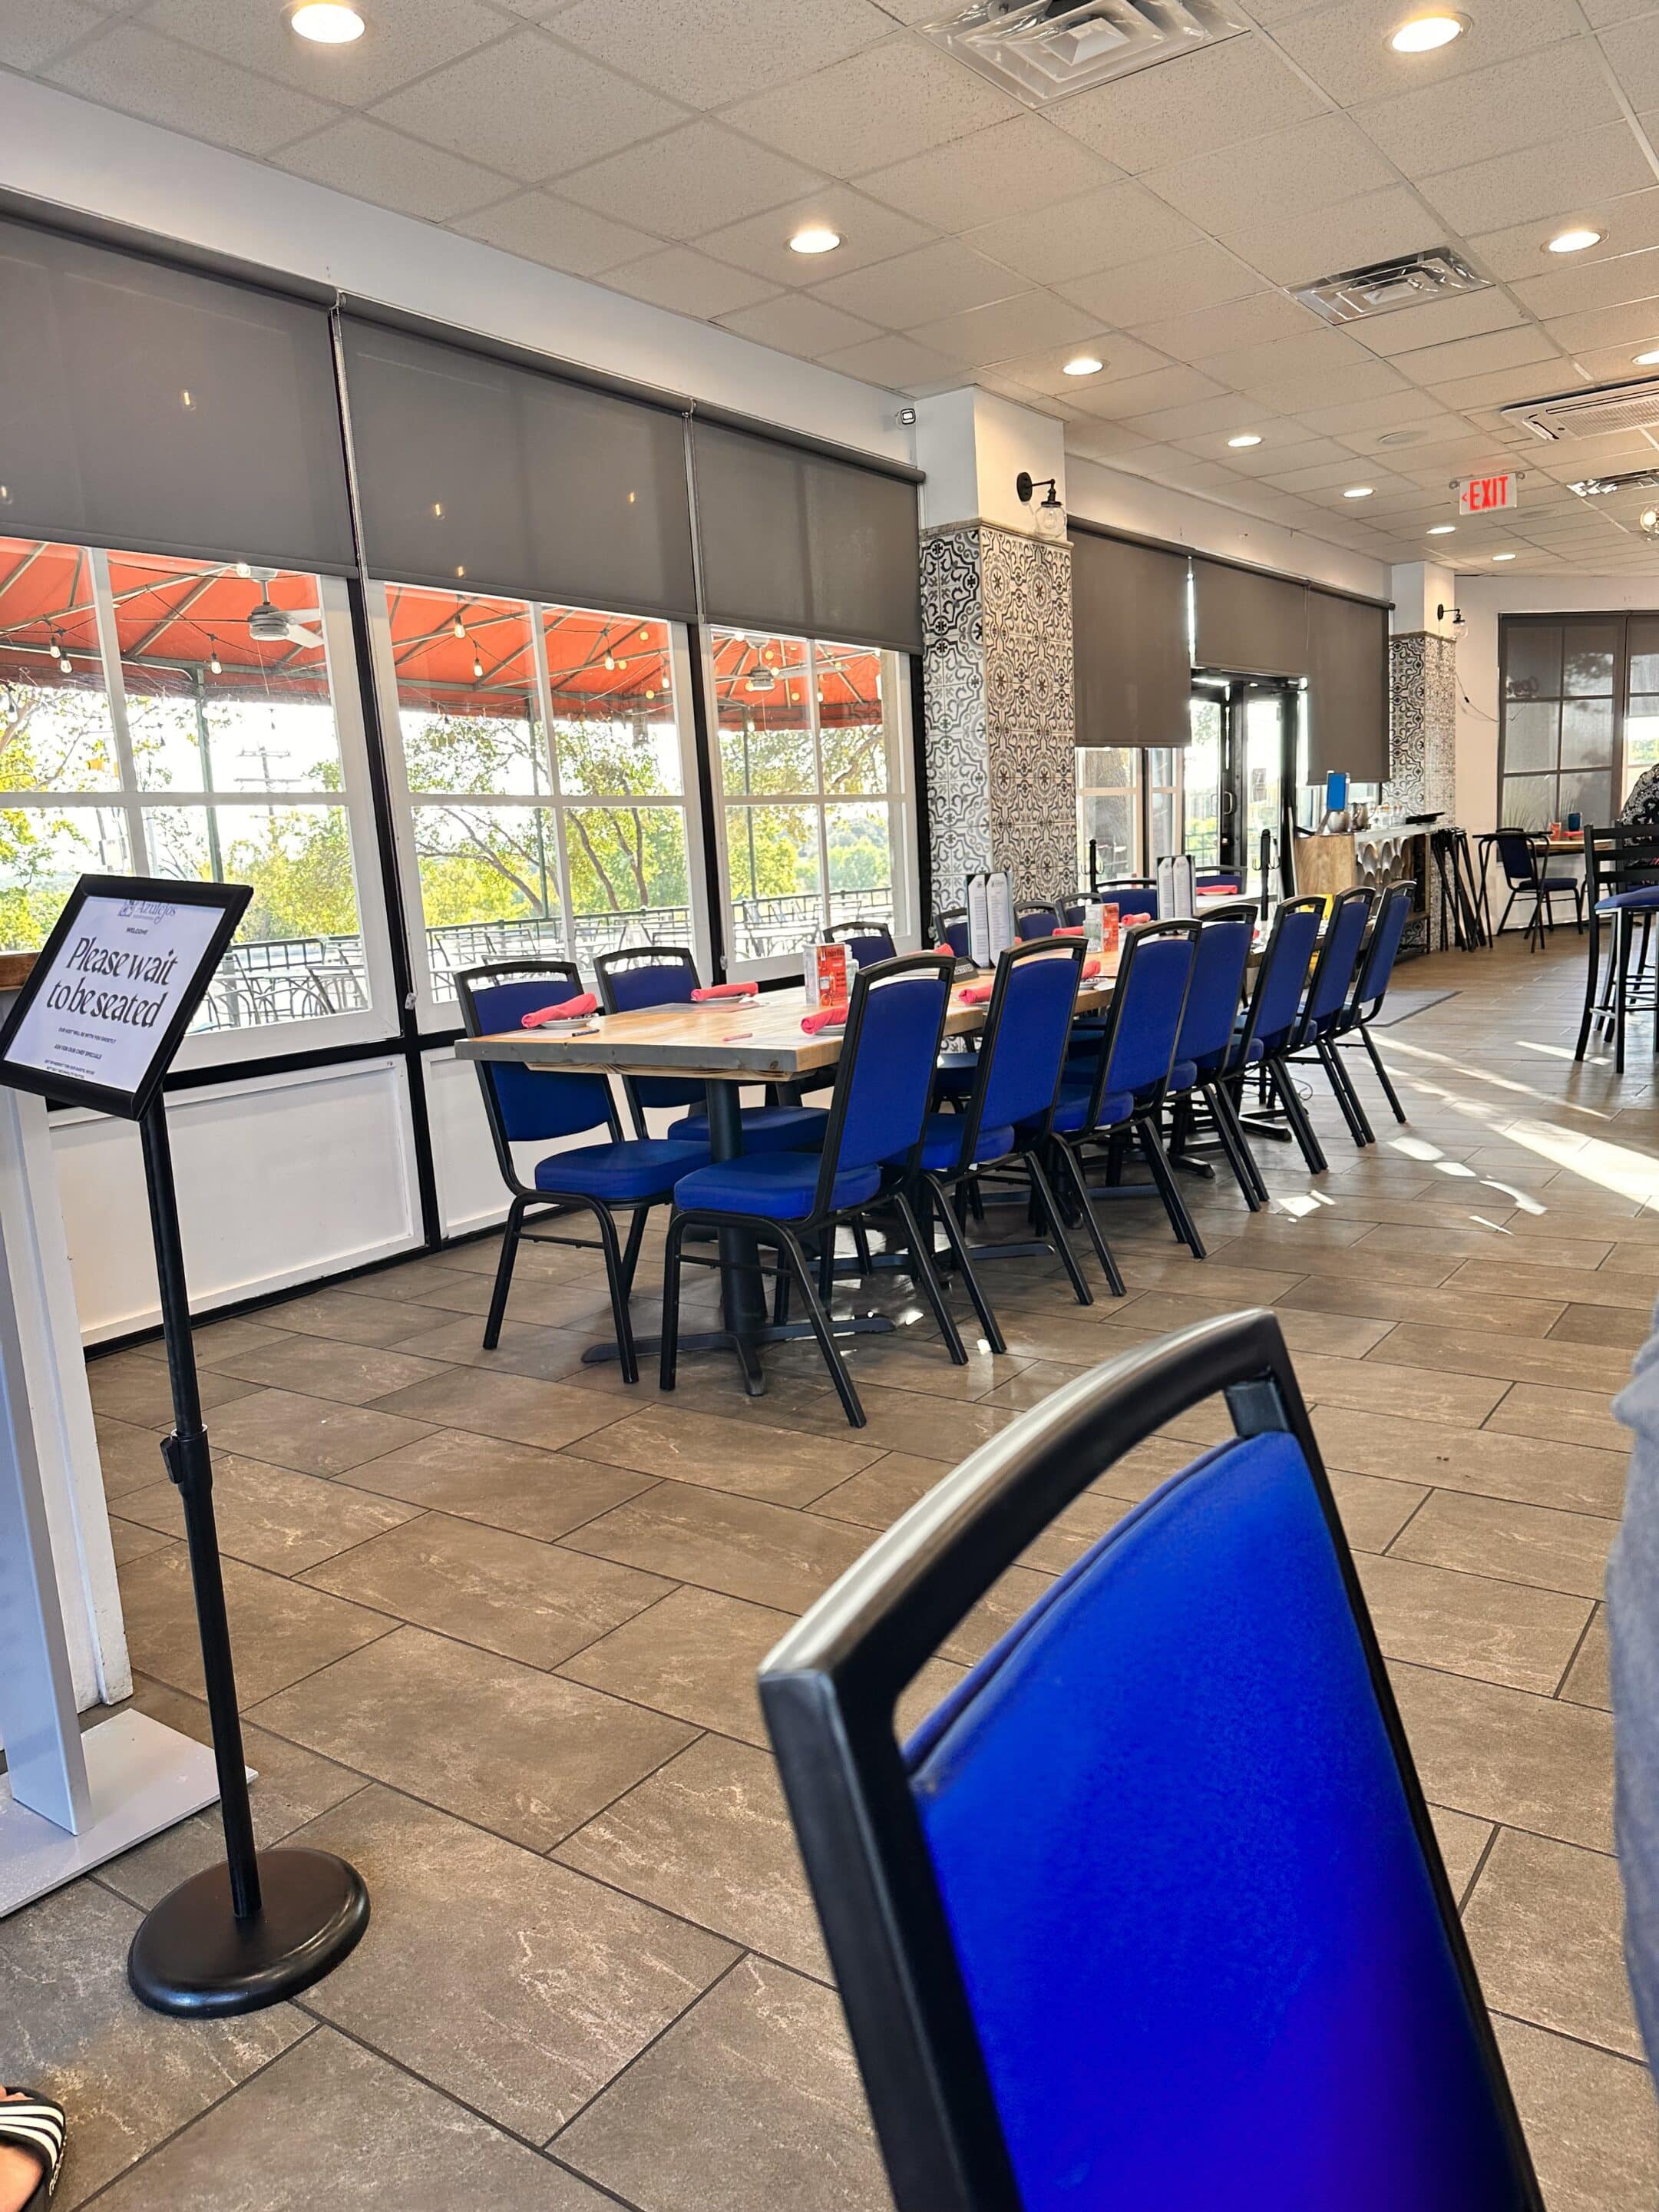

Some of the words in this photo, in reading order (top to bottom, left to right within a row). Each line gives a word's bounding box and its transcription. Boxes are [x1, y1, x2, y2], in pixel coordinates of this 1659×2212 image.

[1469, 475, 1509, 511] EXIT
[66, 936, 131, 977] Please
[127, 948, 178, 986] wait
[46, 980, 71, 1010] to
[68, 976, 96, 1015] be
[90, 991, 169, 1028] seated
